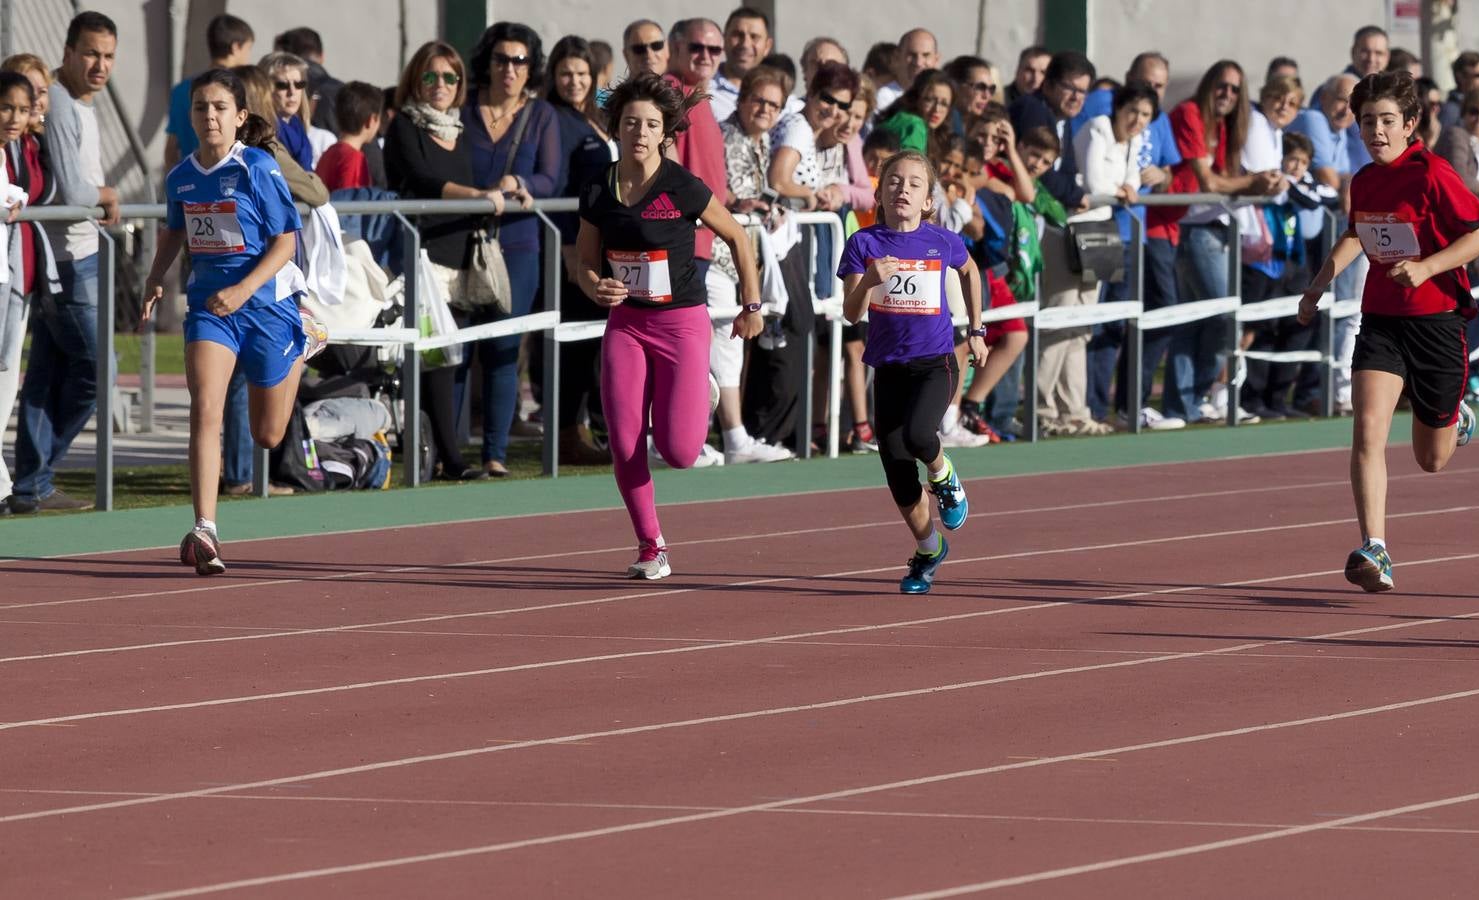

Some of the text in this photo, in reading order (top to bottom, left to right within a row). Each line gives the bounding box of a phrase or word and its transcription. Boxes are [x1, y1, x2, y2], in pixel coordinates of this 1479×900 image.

[641, 209, 682, 219] adidas
[191, 216, 215, 236] 28
[620, 265, 641, 285] 27
[888, 274, 917, 295] 26
